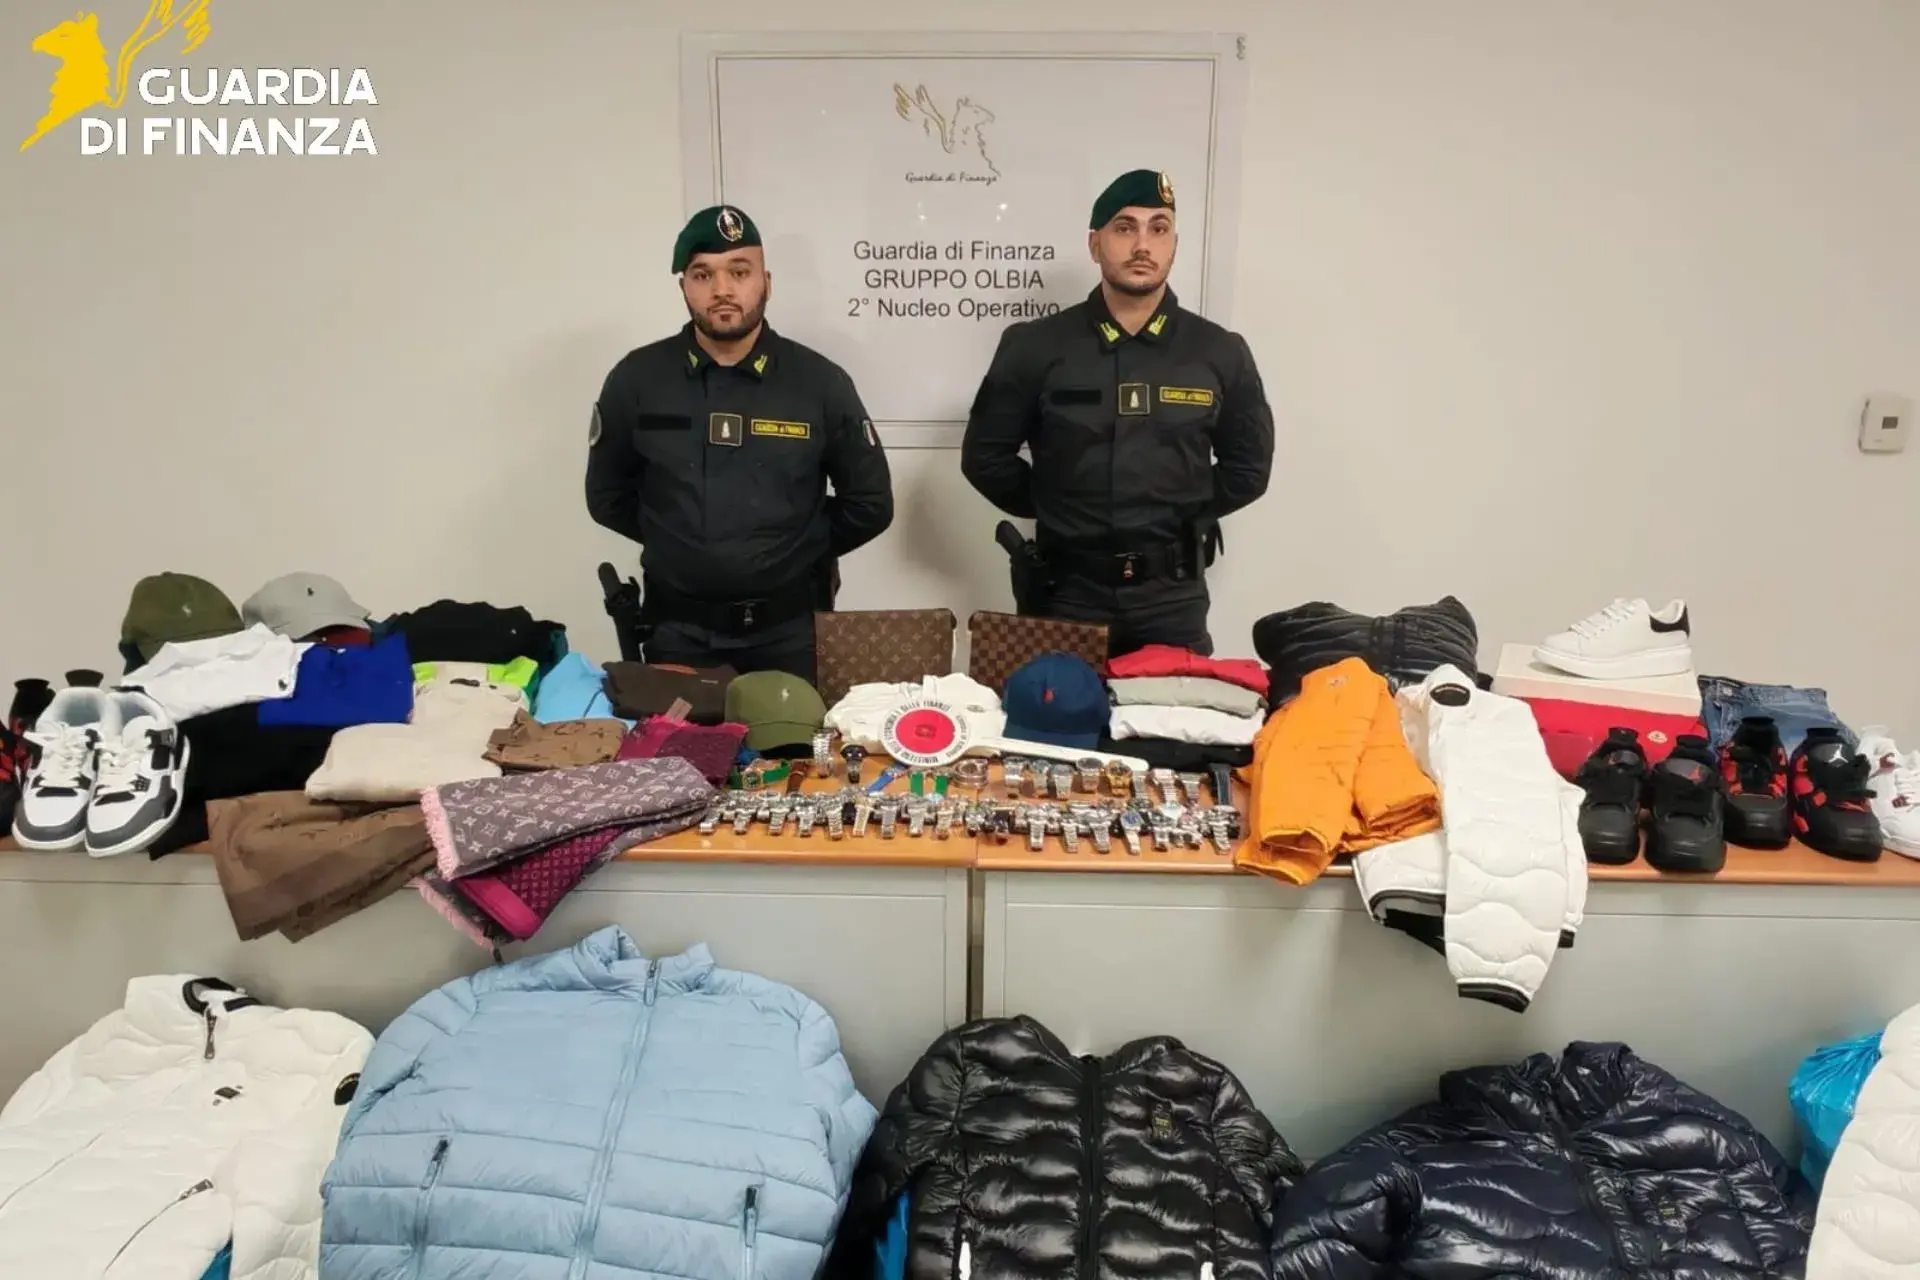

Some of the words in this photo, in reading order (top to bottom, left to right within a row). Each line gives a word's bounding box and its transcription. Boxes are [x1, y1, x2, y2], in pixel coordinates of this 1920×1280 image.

[853, 240, 937, 260] Guardia
[944, 240, 963, 260] di
[971, 240, 1055, 260] Finanza
[864, 269, 967, 289] GRUPPO
[974, 269, 1045, 289] OLBIA
[848, 298, 870, 317] 2°
[878, 298, 950, 317] Nucleo
[957, 298, 1060, 322] Operativo
